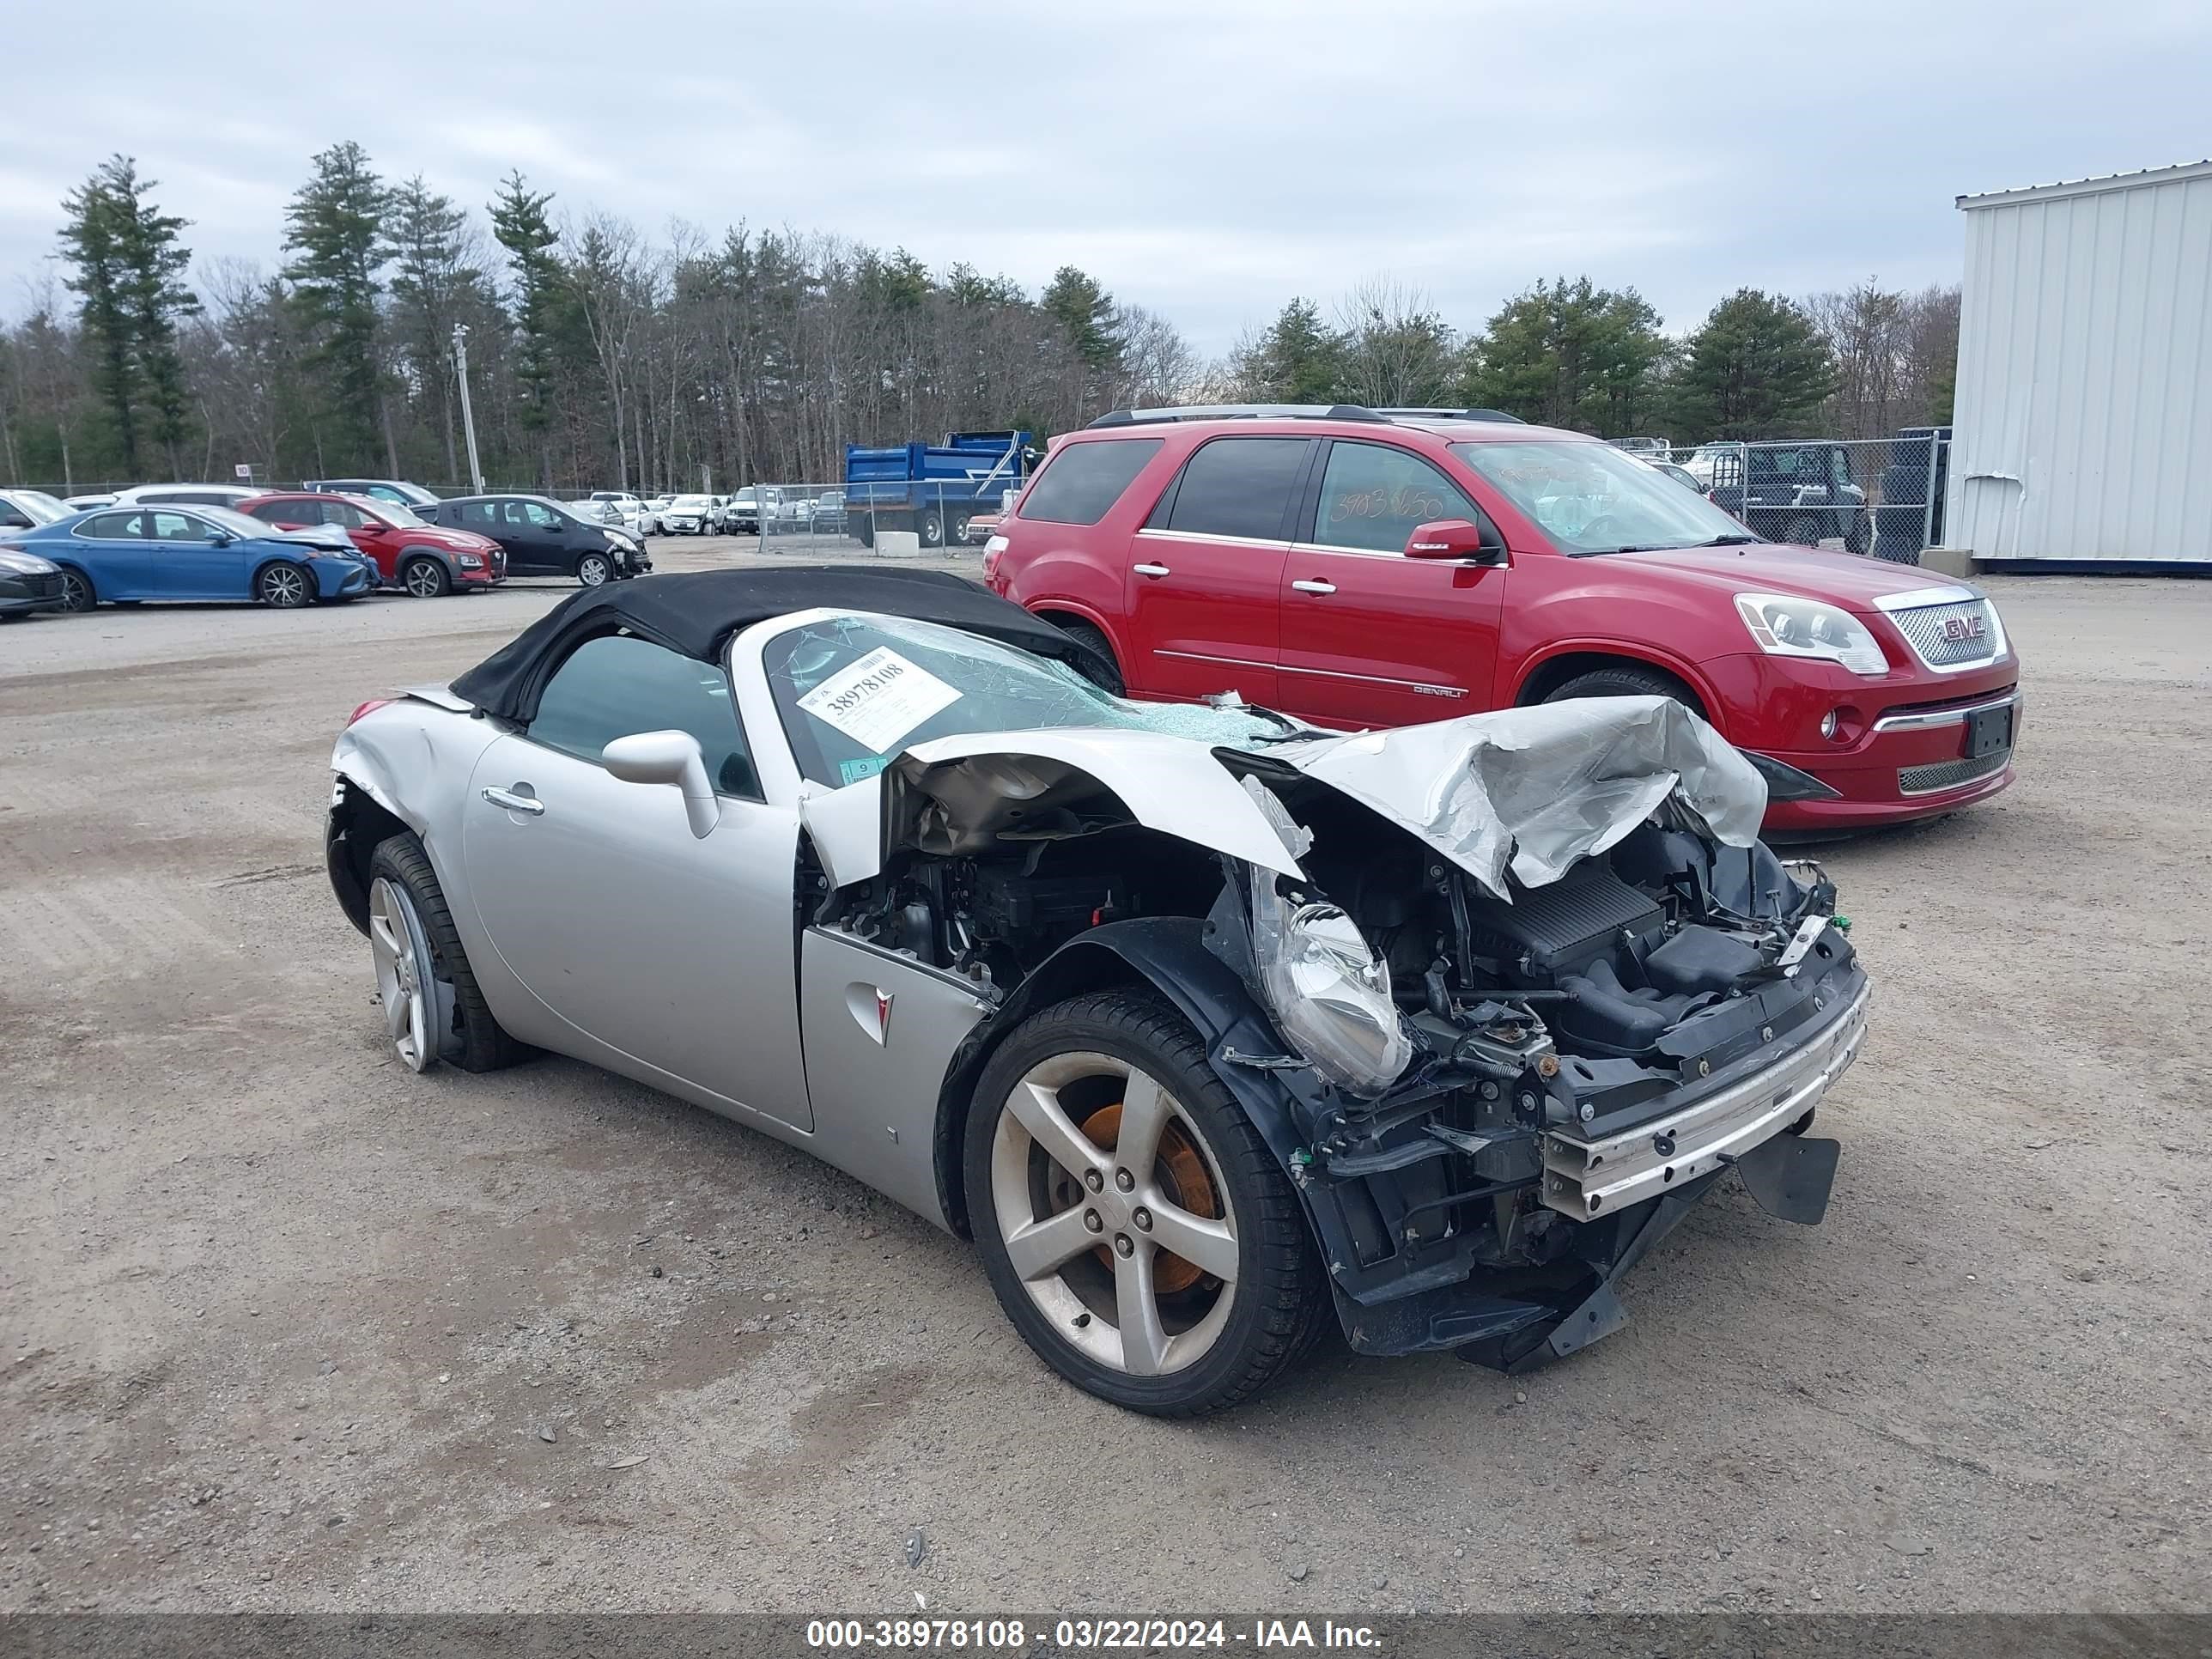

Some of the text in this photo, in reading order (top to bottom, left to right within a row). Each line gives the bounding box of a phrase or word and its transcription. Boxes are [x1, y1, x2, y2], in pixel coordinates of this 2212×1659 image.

[238, 466, 247, 475] 10
[1944, 616, 1986, 641] GMC
[827, 663, 904, 716] 38978108
[1413, 686, 1462, 699] DENALI
[860, 763, 868, 773] 9
